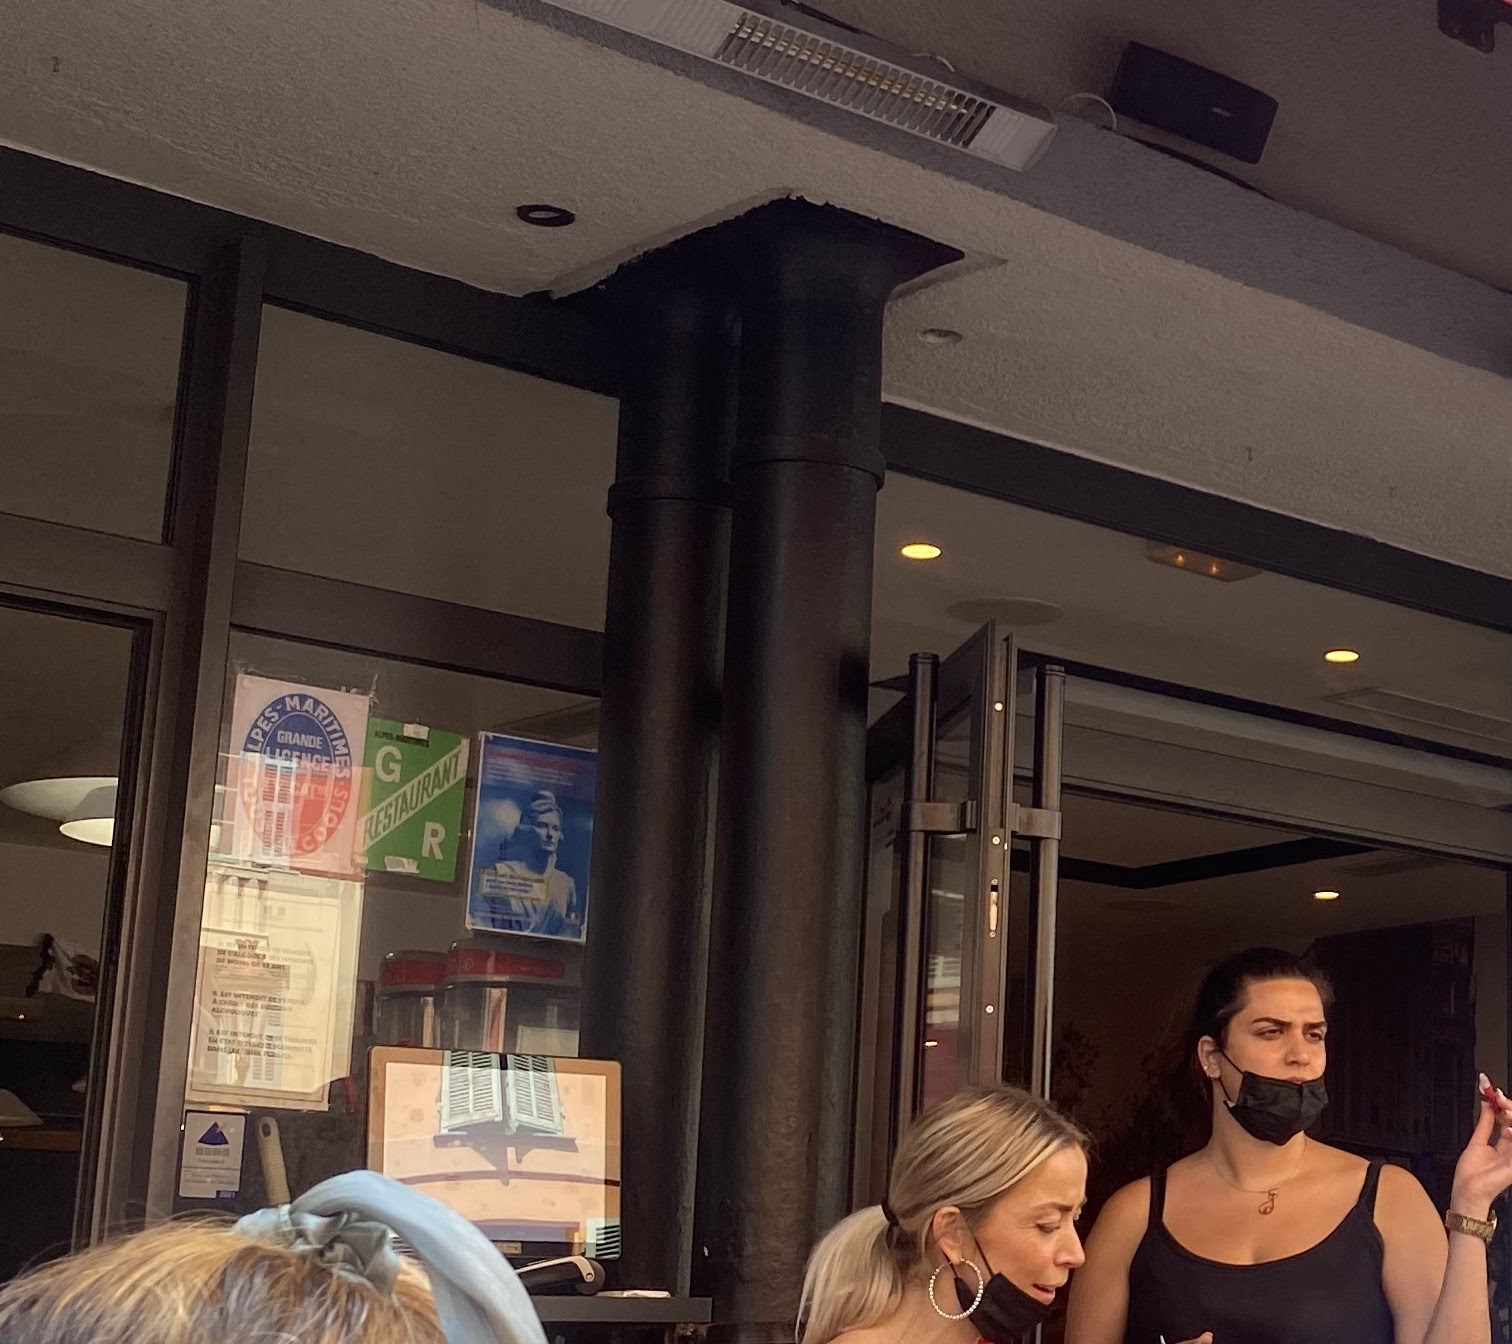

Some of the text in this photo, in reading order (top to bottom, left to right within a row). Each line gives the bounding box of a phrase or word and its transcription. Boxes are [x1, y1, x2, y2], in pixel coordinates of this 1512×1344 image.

[246, 695, 351, 780] LPES-MARITIMES
[277, 730, 324, 750] GRANDE
[375, 745, 403, 784] G
[364, 750, 462, 849] RESTAURANT
[421, 821, 446, 861] R
